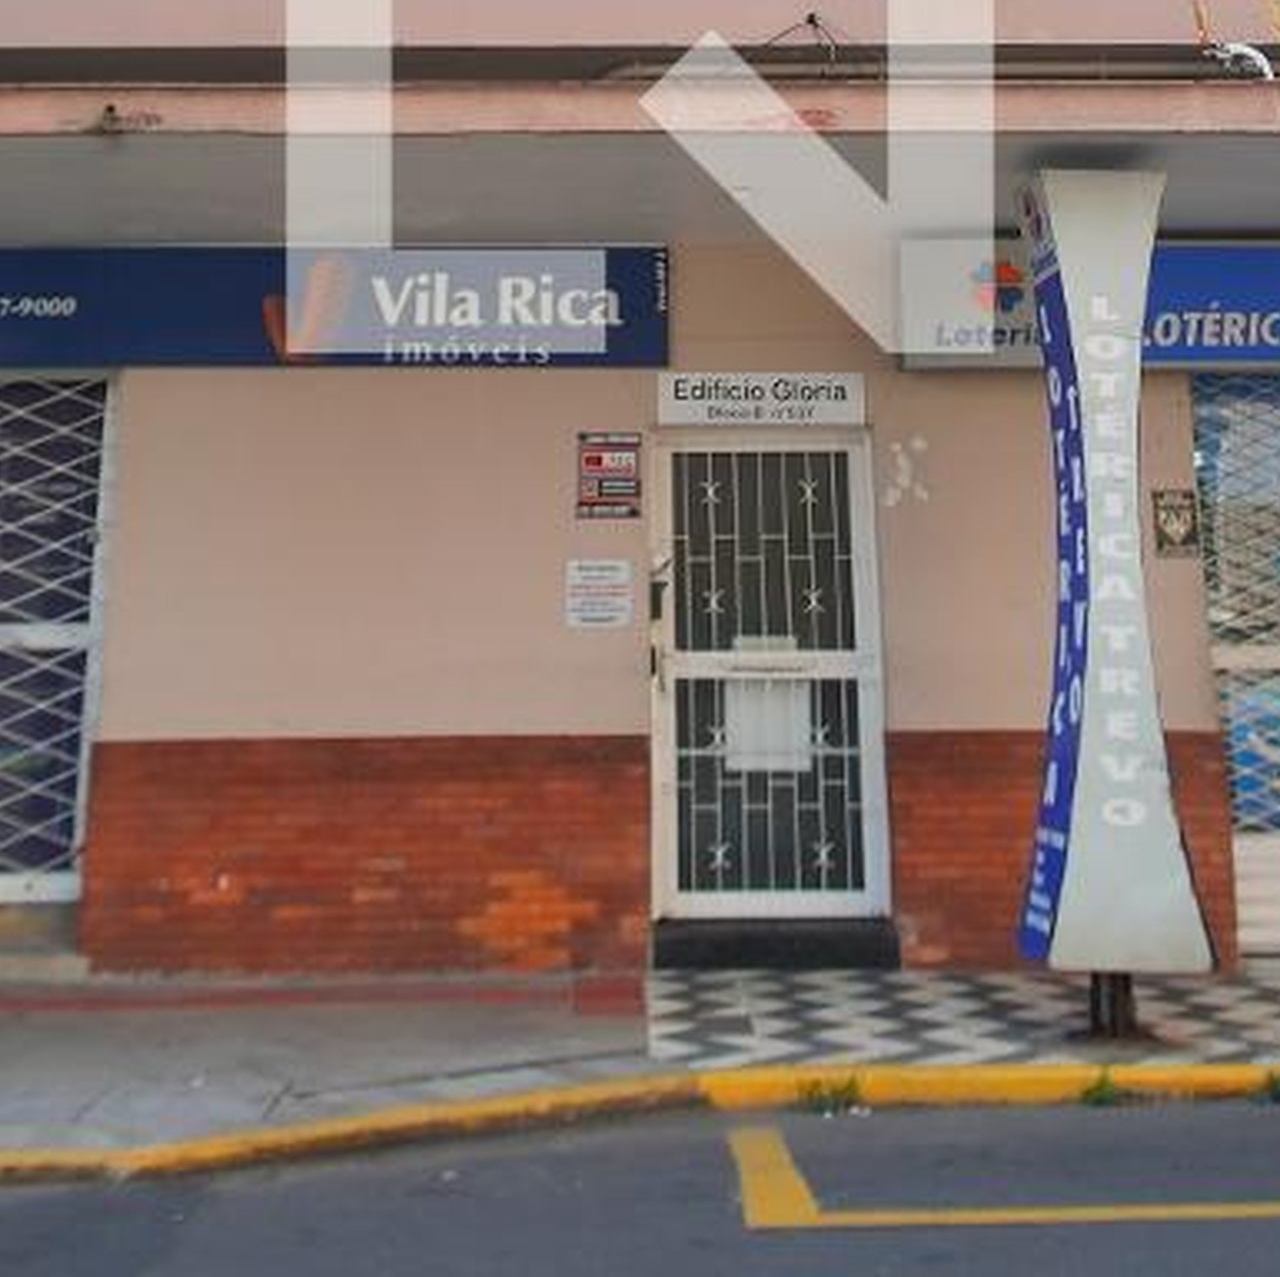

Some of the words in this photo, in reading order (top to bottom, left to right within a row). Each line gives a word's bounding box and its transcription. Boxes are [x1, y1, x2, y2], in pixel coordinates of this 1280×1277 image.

[370, 272, 483, 327] Vila
[496, 274, 624, 327] Rica
[383, 335, 552, 365] imóveis
